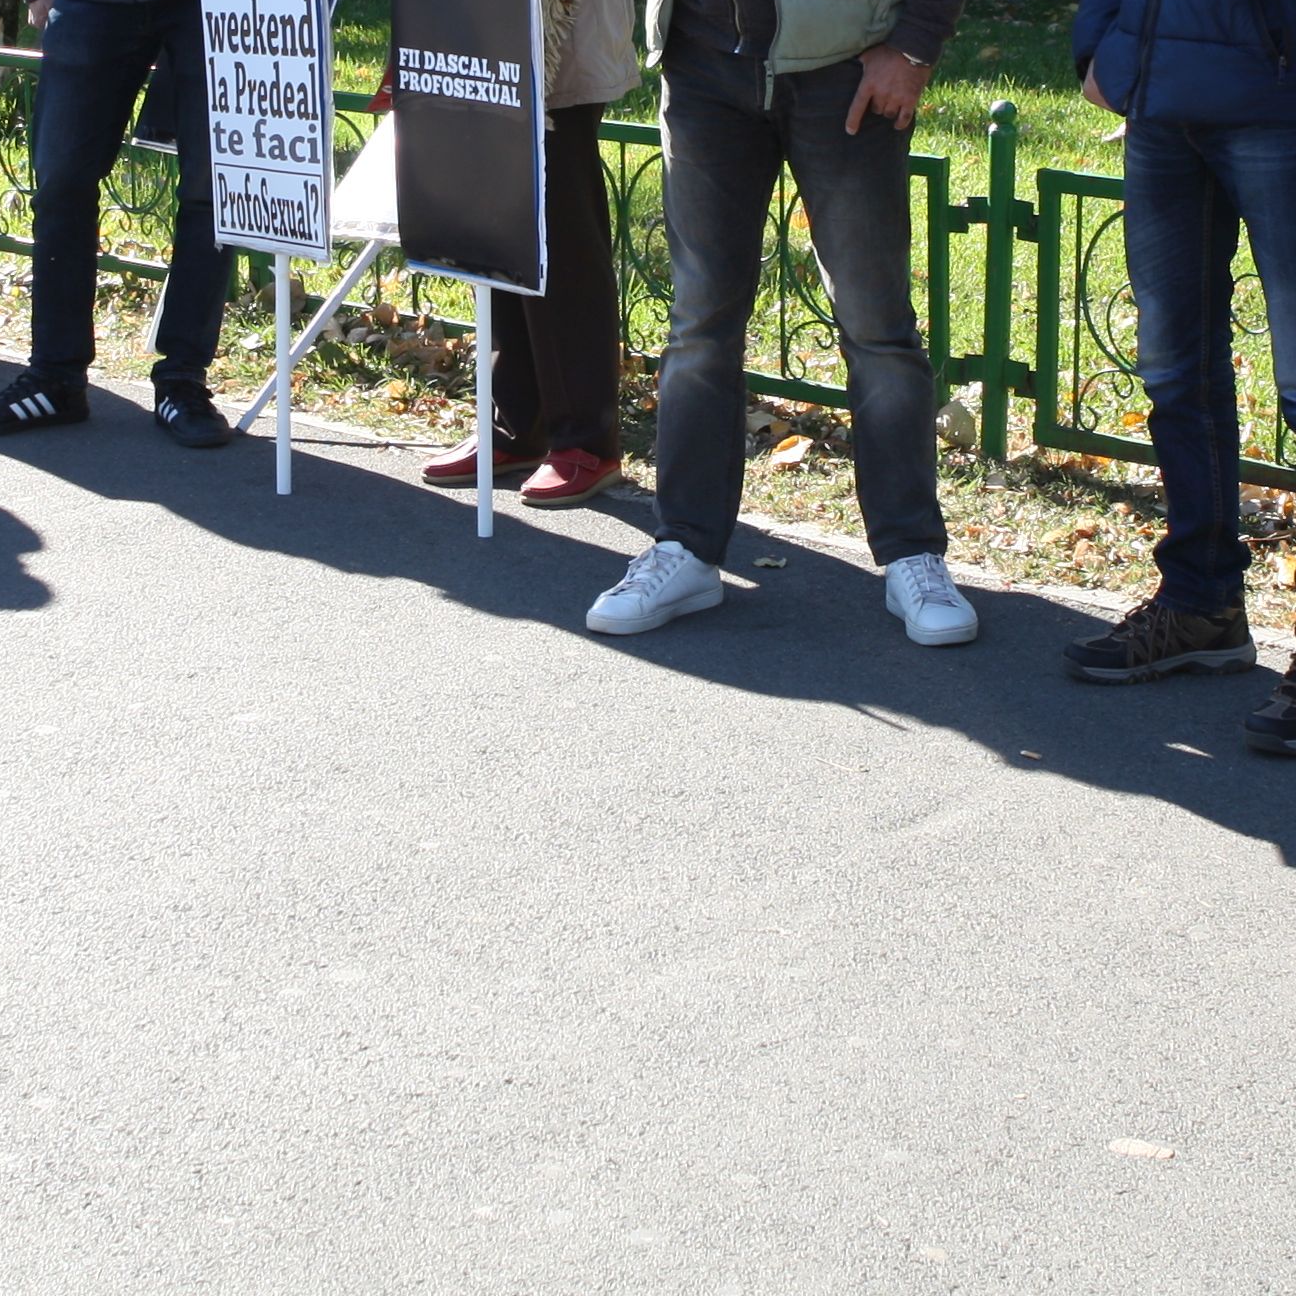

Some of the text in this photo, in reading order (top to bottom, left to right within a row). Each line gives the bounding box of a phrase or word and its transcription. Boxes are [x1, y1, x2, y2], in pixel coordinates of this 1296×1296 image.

[208, 56, 320, 121] la Predeal
[398, 46, 522, 86] FII DASCAL, NU
[398, 68, 522, 108] PROFOSEXUAL
[212, 118, 321, 165] te faci
[217, 171, 320, 243] ProfoSexual?
